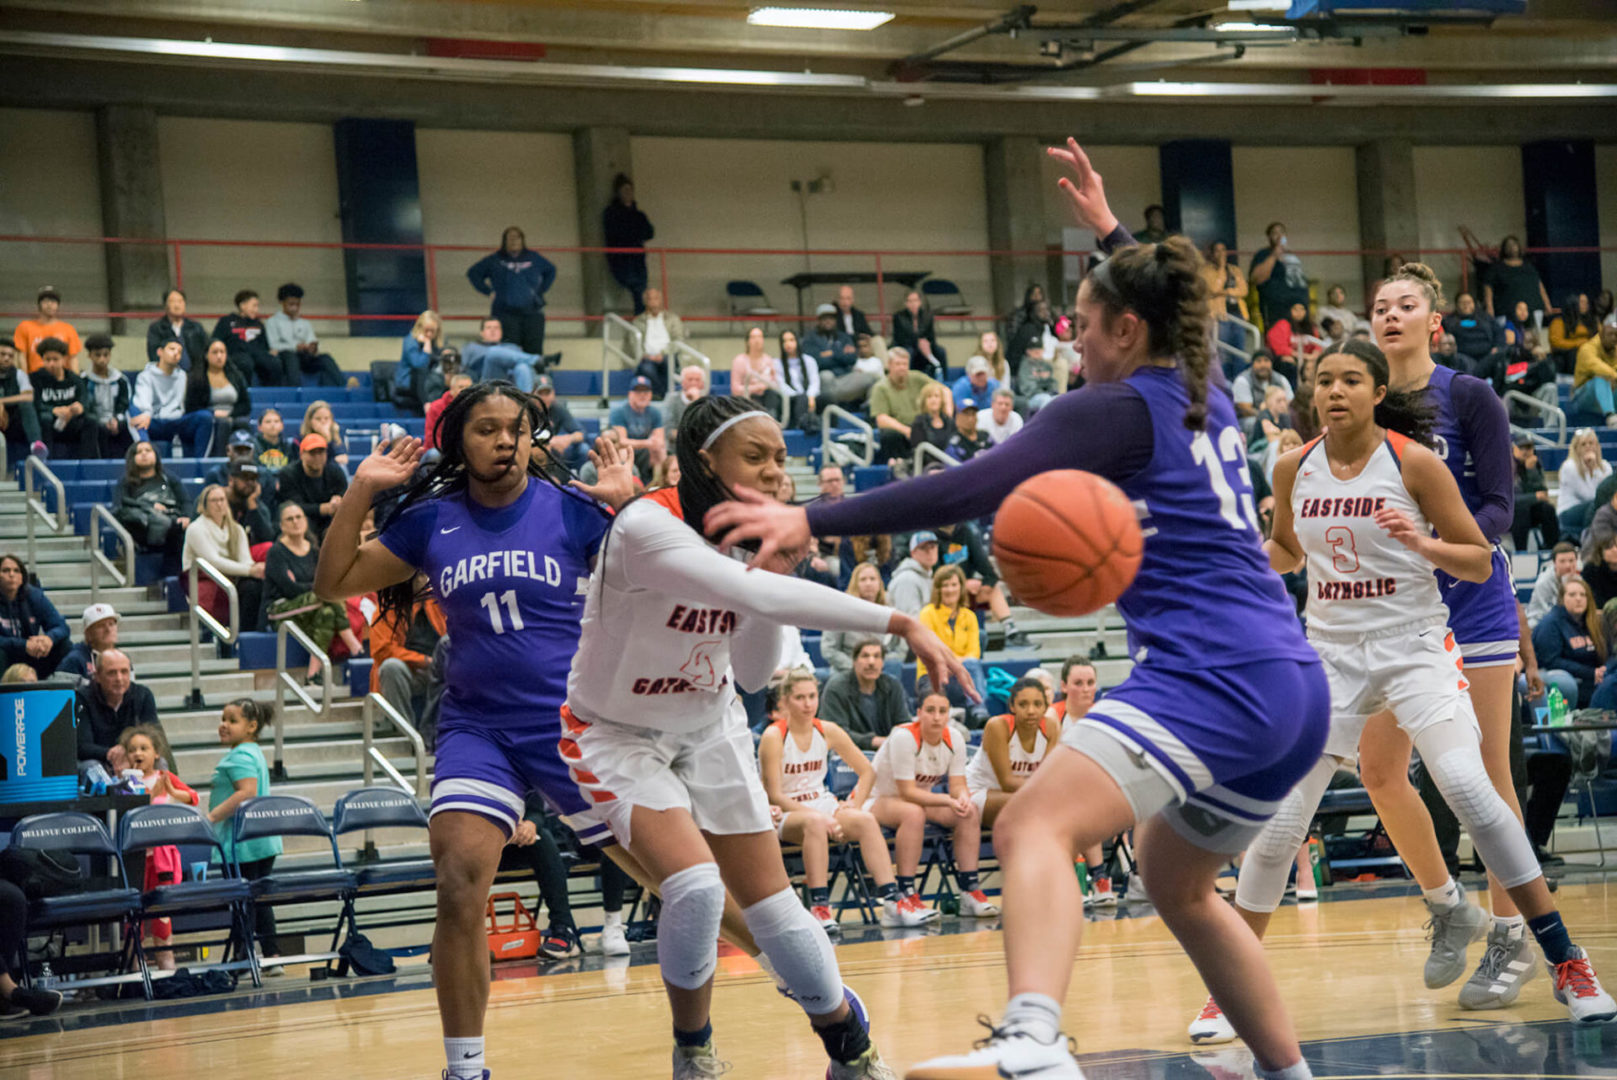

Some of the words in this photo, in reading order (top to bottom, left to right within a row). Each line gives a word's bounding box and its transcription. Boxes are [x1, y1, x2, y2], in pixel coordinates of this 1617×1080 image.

[1190, 426, 1259, 533] 13
[1300, 497, 1386, 518] EASTSIDE
[1325, 526, 1360, 573] 3
[440, 550, 562, 598] GARFIELD
[480, 590, 524, 634] 11
[665, 604, 736, 634] EASTS
[14, 698, 27, 776] POWERADE
[245, 809, 280, 819] BELLEVUE
[281, 807, 314, 817] COLLEGE
[345, 800, 379, 809] BELLEVUE
[380, 799, 411, 808] COLLEGE
[22, 828, 61, 838] BELLEVUE
[62, 825, 98, 834] COLLEGE
[130, 818, 166, 828] BELLEVUE
[168, 816, 201, 826] COLLEGE
